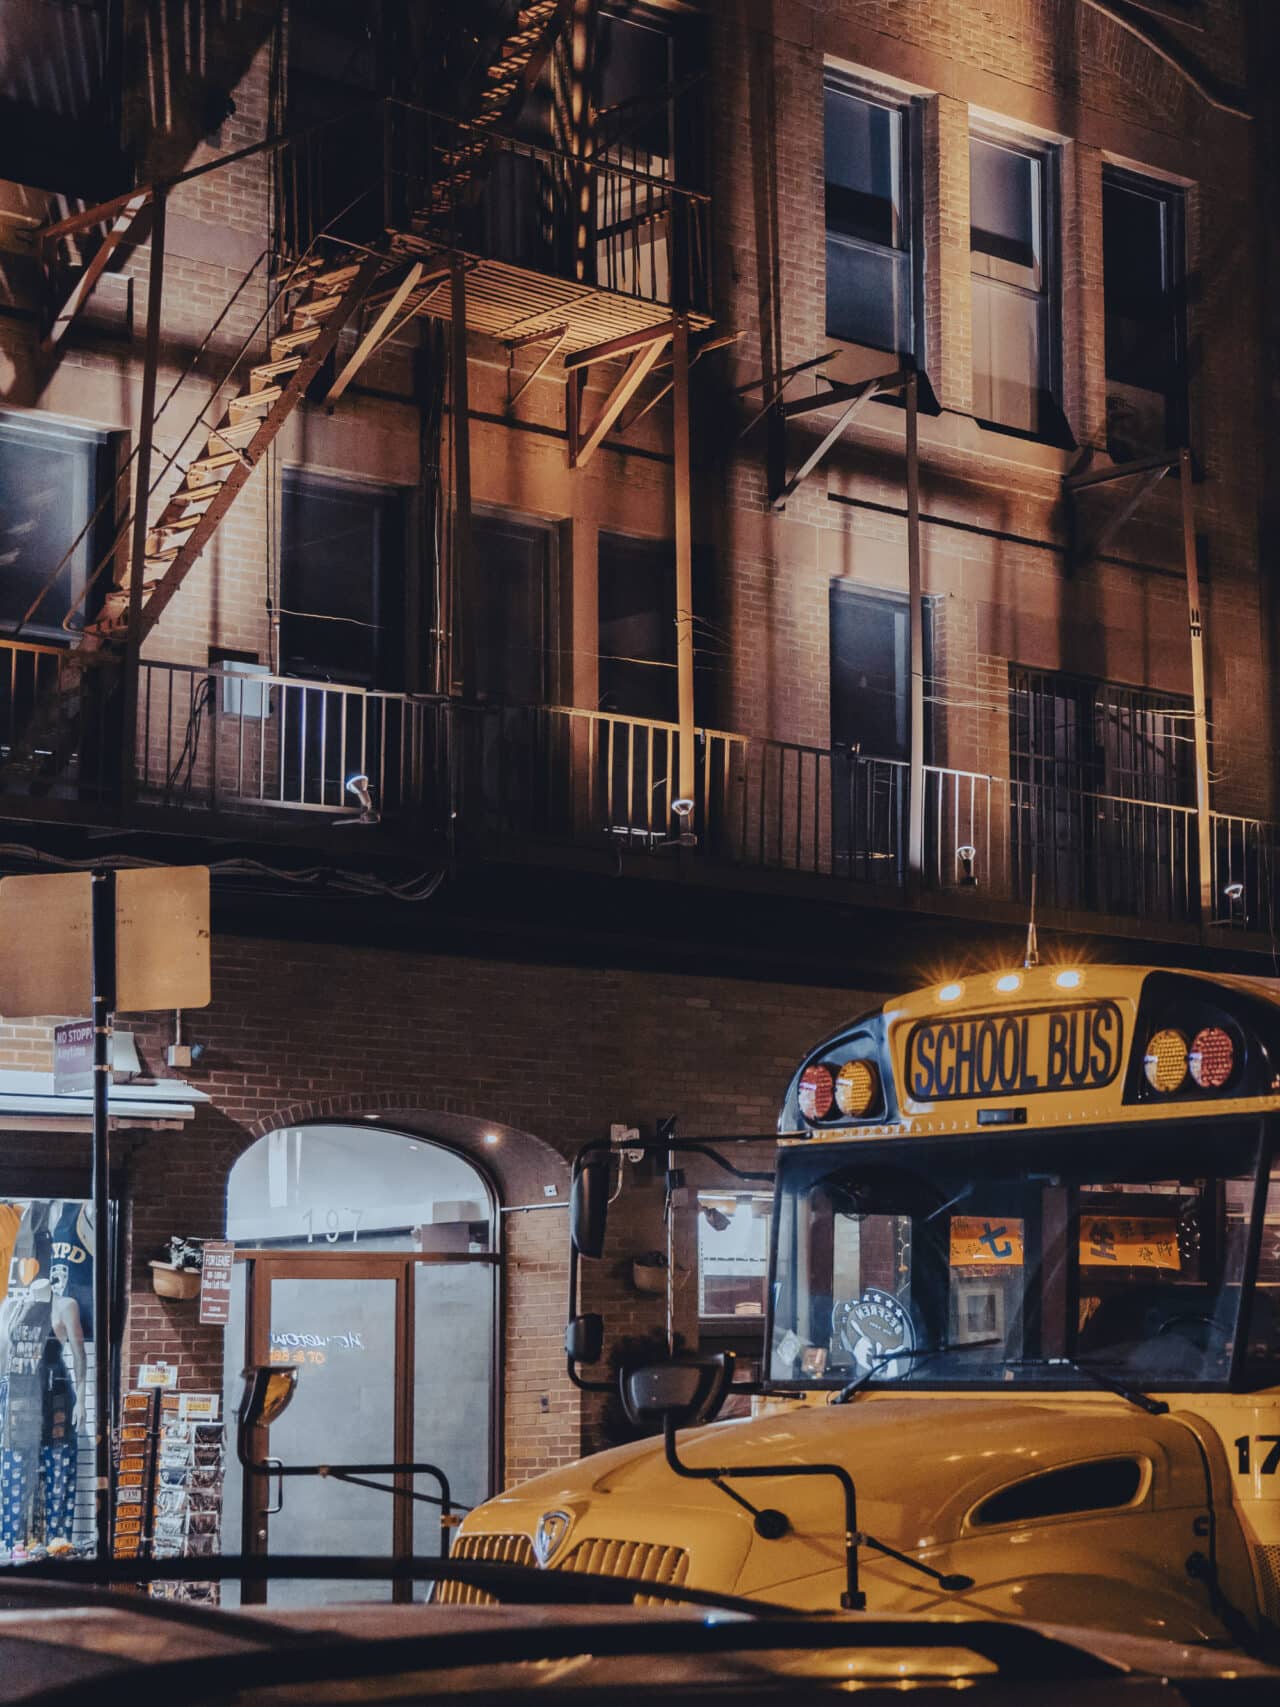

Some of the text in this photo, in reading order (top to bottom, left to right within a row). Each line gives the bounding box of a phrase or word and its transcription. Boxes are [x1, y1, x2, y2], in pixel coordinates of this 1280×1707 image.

[56, 1032, 68, 1044] NO
[915, 1009, 1112, 1097] SCHOOL BUS
[302, 1208, 363, 1243] 197
[51, 1242, 87, 1265] YPD
